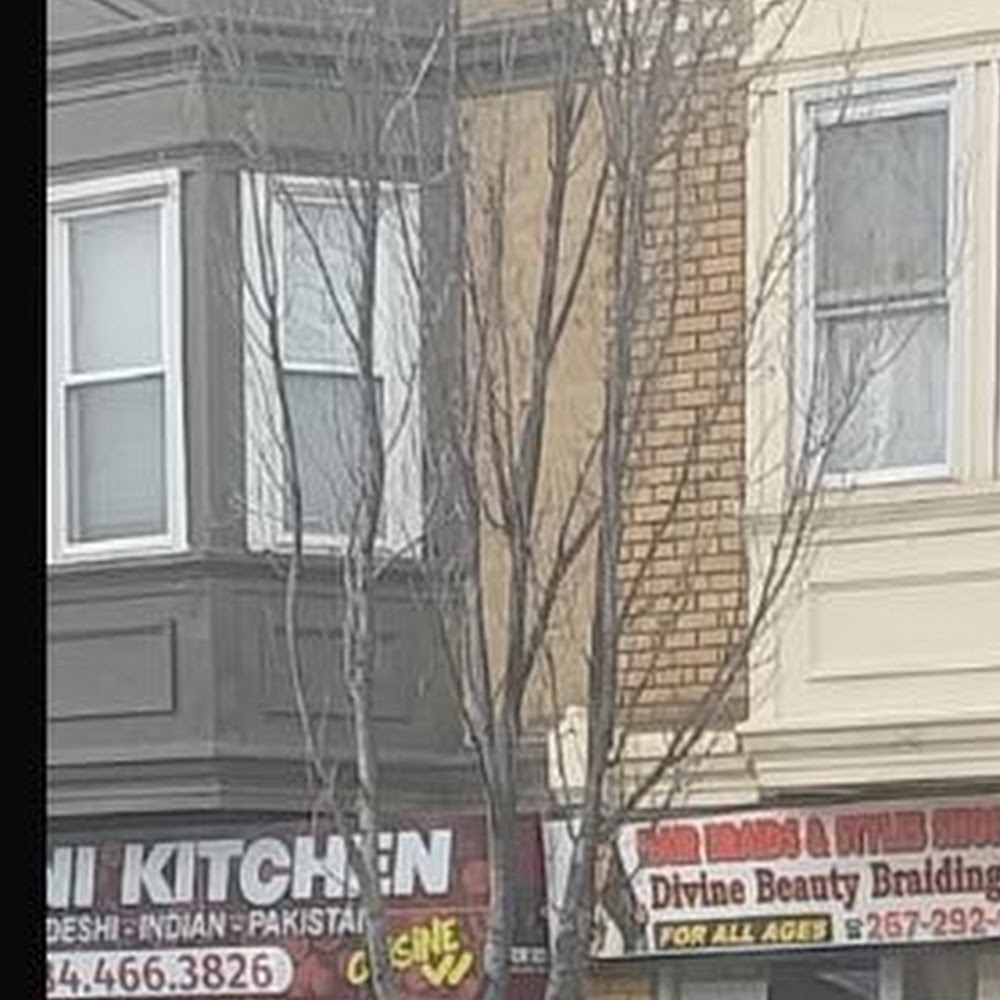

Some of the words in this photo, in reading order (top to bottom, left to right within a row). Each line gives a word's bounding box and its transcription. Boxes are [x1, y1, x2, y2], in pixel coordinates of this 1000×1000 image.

[650, 871, 746, 909] Divine
[755, 863, 860, 910] Beauty
[138, 911, 226, 941] INDIAN
[660, 924, 707, 948] FOR
[711, 920, 755, 943] ALL
[761, 918, 828, 943] AGES
